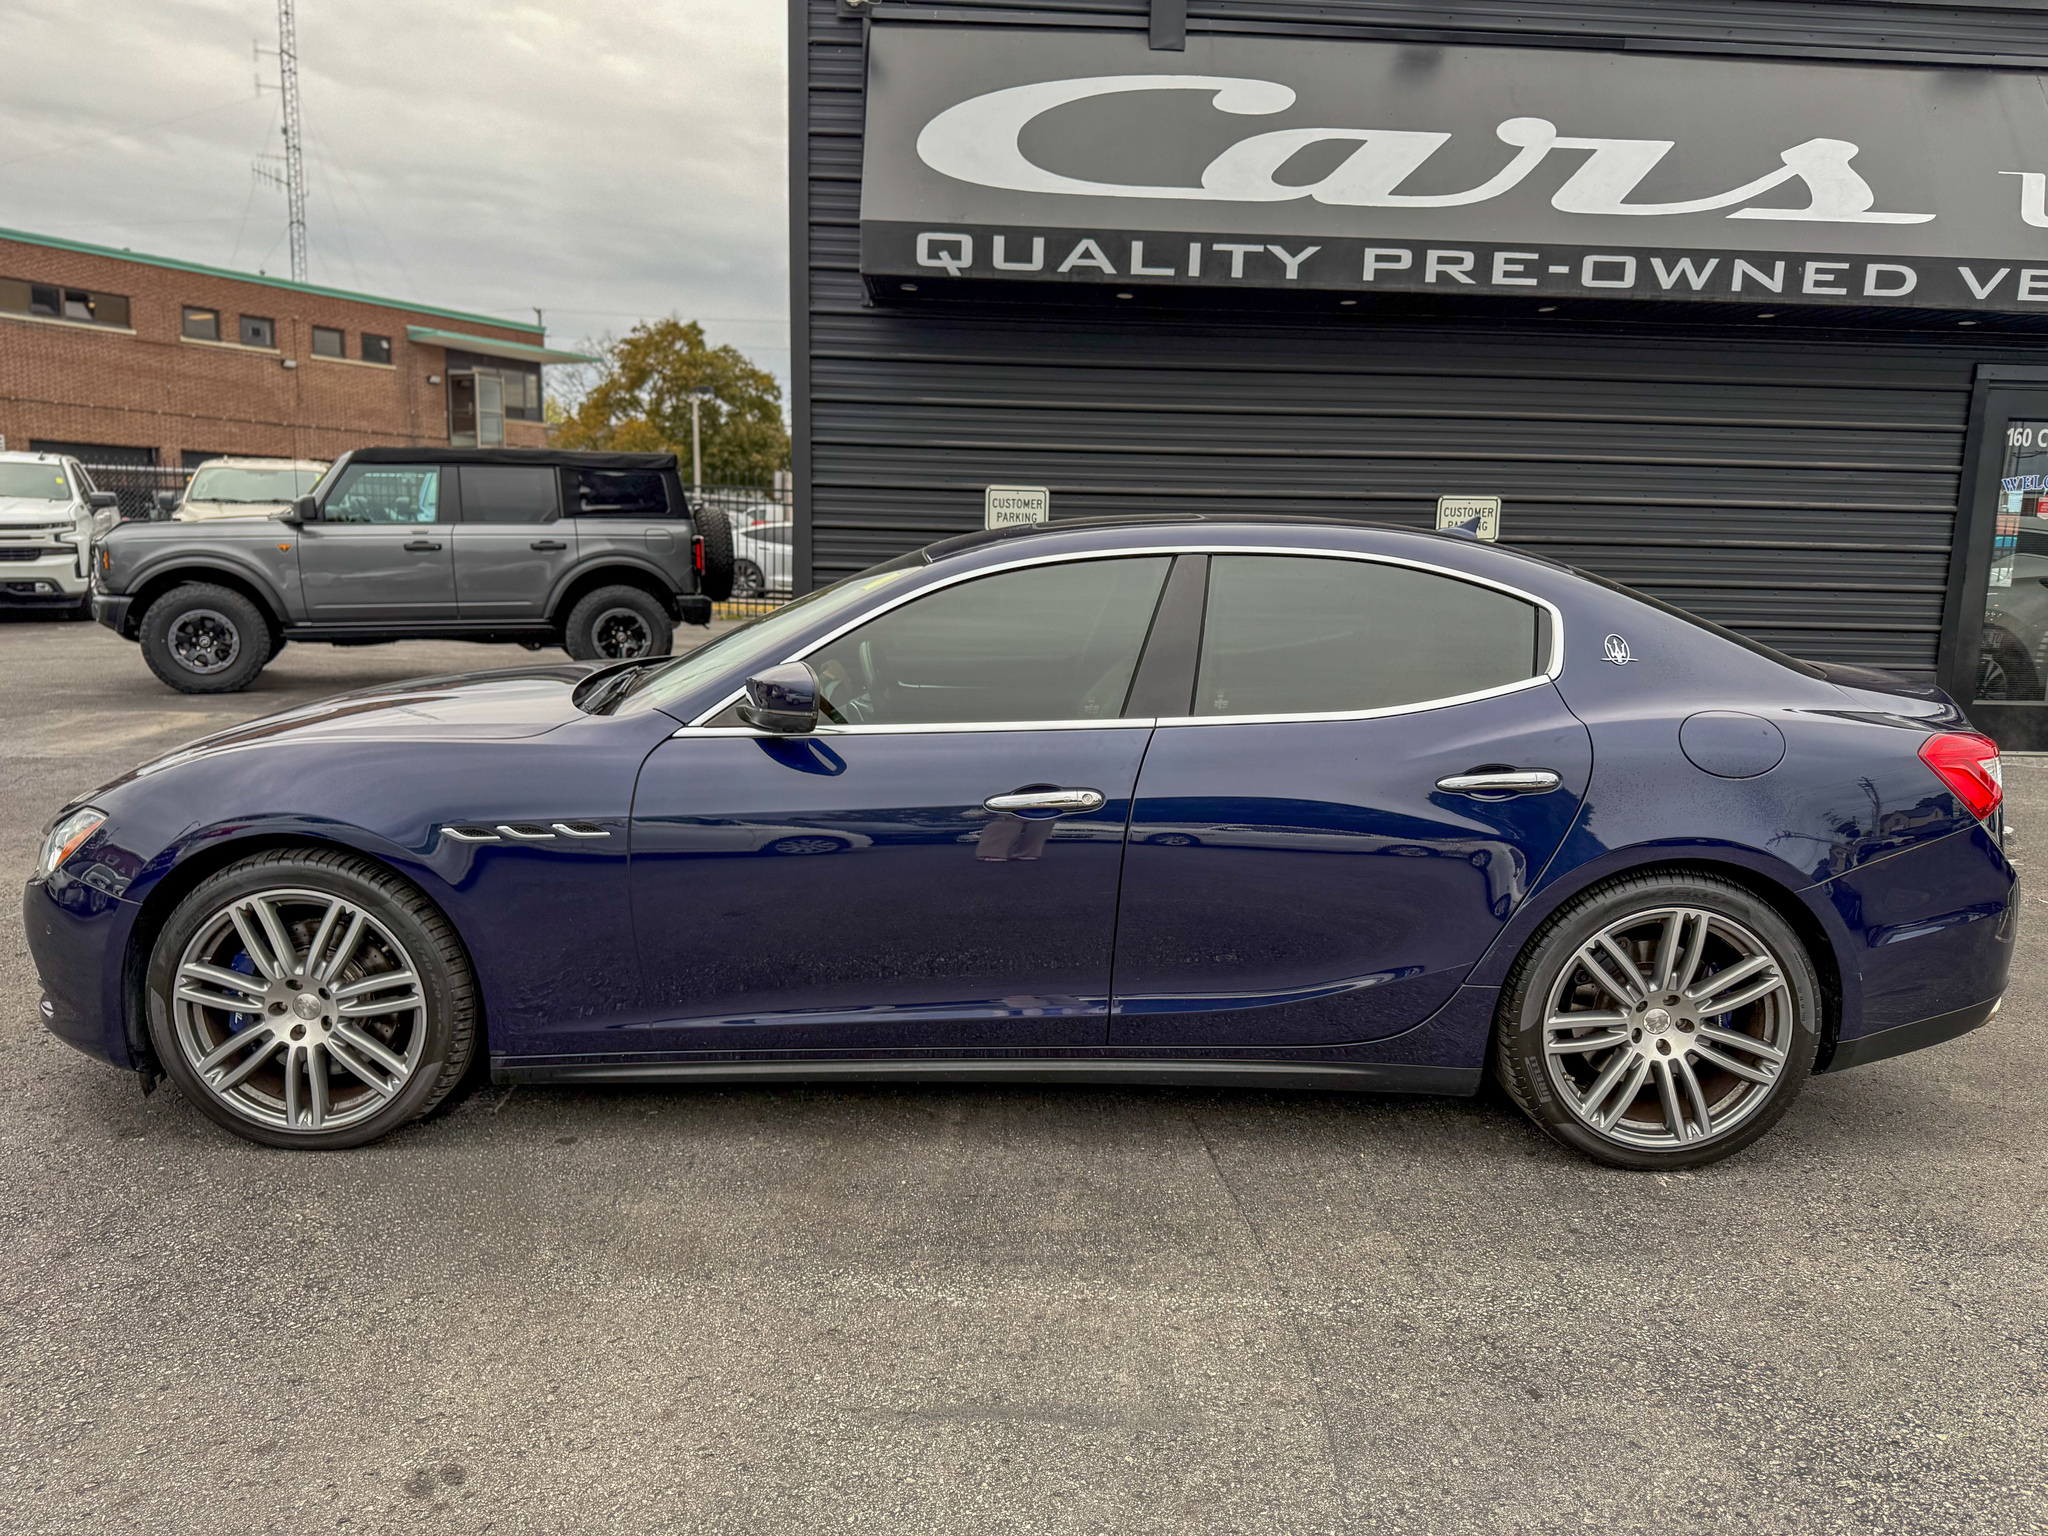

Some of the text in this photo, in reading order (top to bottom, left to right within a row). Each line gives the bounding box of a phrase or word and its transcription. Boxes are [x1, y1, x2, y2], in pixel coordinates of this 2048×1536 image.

[916, 74, 1937, 225] Cars
[916, 232, 1322, 280] QUALITY
[1362, 247, 1918, 297] PRE-OWNED
[2006, 427, 2033, 447] 160
[992, 497, 1043, 509] CUSTOMER
[1443, 506, 1494, 518] CUSTOMER
[996, 511, 1038, 523] PARKING
[1524, 1055, 1553, 1104] PIRELLI
